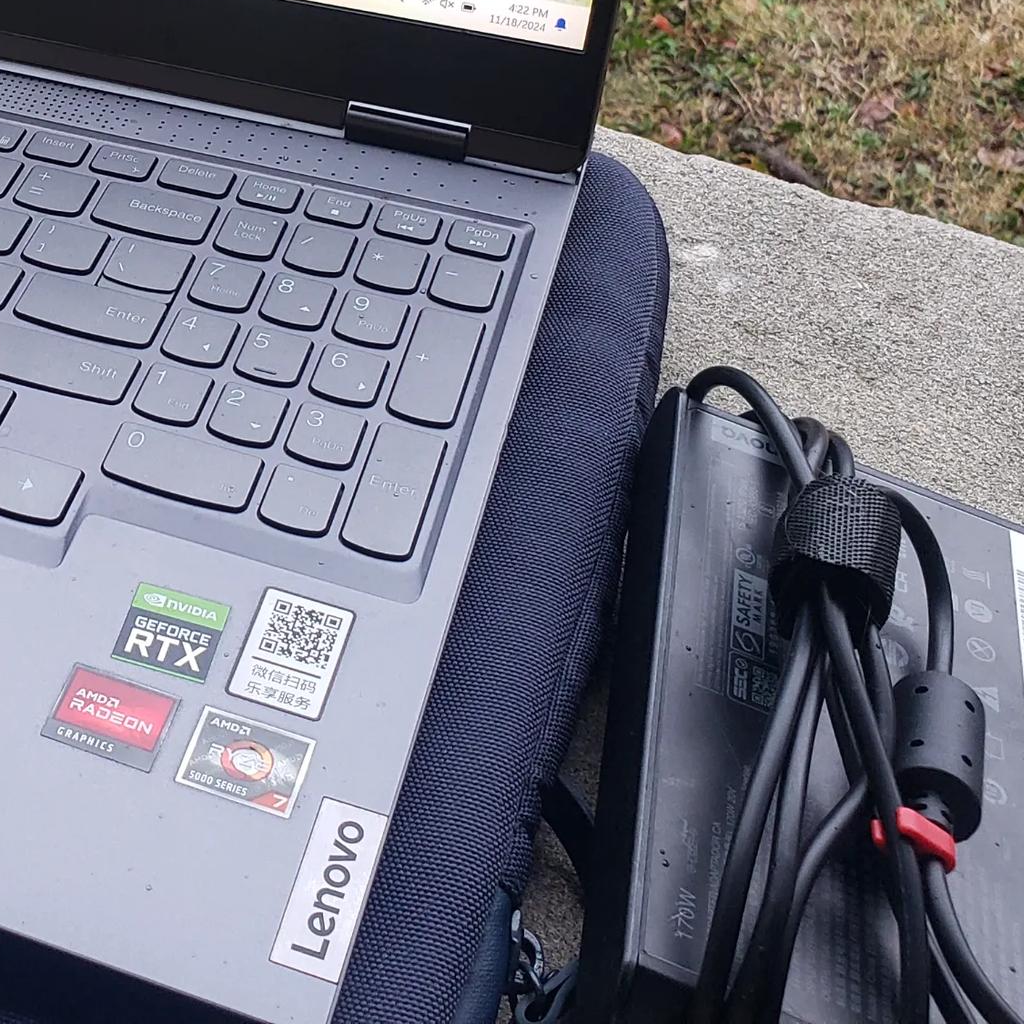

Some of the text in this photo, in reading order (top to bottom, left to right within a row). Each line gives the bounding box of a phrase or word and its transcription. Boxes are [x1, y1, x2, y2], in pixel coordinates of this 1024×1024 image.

[508, 3, 549, 19] 4:22 PM
[489, 14, 546, 32] 11/18/2024
[42, 136, 74, 150] Insert
[253, 181, 286, 194] Home
[327, 196, 351, 208] End
[130, 198, 202, 223] Backspace
[394, 209, 427, 225] PgUp
[237, 220, 266, 233] Num
[465, 226, 500, 241] PgDn
[233, 229, 262, 242] Lock
[210, 262, 226, 276] 7
[278, 278, 294, 294] 8
[352, 296, 369, 312] 9
[105, 306, 147, 325] Enter
[181, 316, 197, 331] 4
[252, 333, 269, 349] 5
[330, 352, 348, 368] 6
[415, 351, 430, 365] +
[79, 361, 118, 381] Shift
[155, 370, 166, 385] 1
[226, 390, 245, 406] 2
[306, 411, 324, 427] 3
[127, 430, 146, 447] 0
[368, 474, 418, 497] Enter
[736, 575, 752, 626] SAFETY
[752, 588, 764, 625] MARK
[135, 616, 212, 647] GEFORCE
[124, 628, 208, 673] RTX
[251, 663, 317, 695] 微信扫码
[76, 688, 120, 709] AMD
[245, 680, 311, 711] 乐享服务
[69, 697, 153, 736] RADEON
[210, 717, 251, 736] AMD
[57, 726, 115, 754] GRAPHICS
[189, 770, 248, 797] 5000 SERIES
[272, 794, 288, 808] 7
[291, 820, 365, 961] Lenovo
[674, 887, 697, 939] 170W
